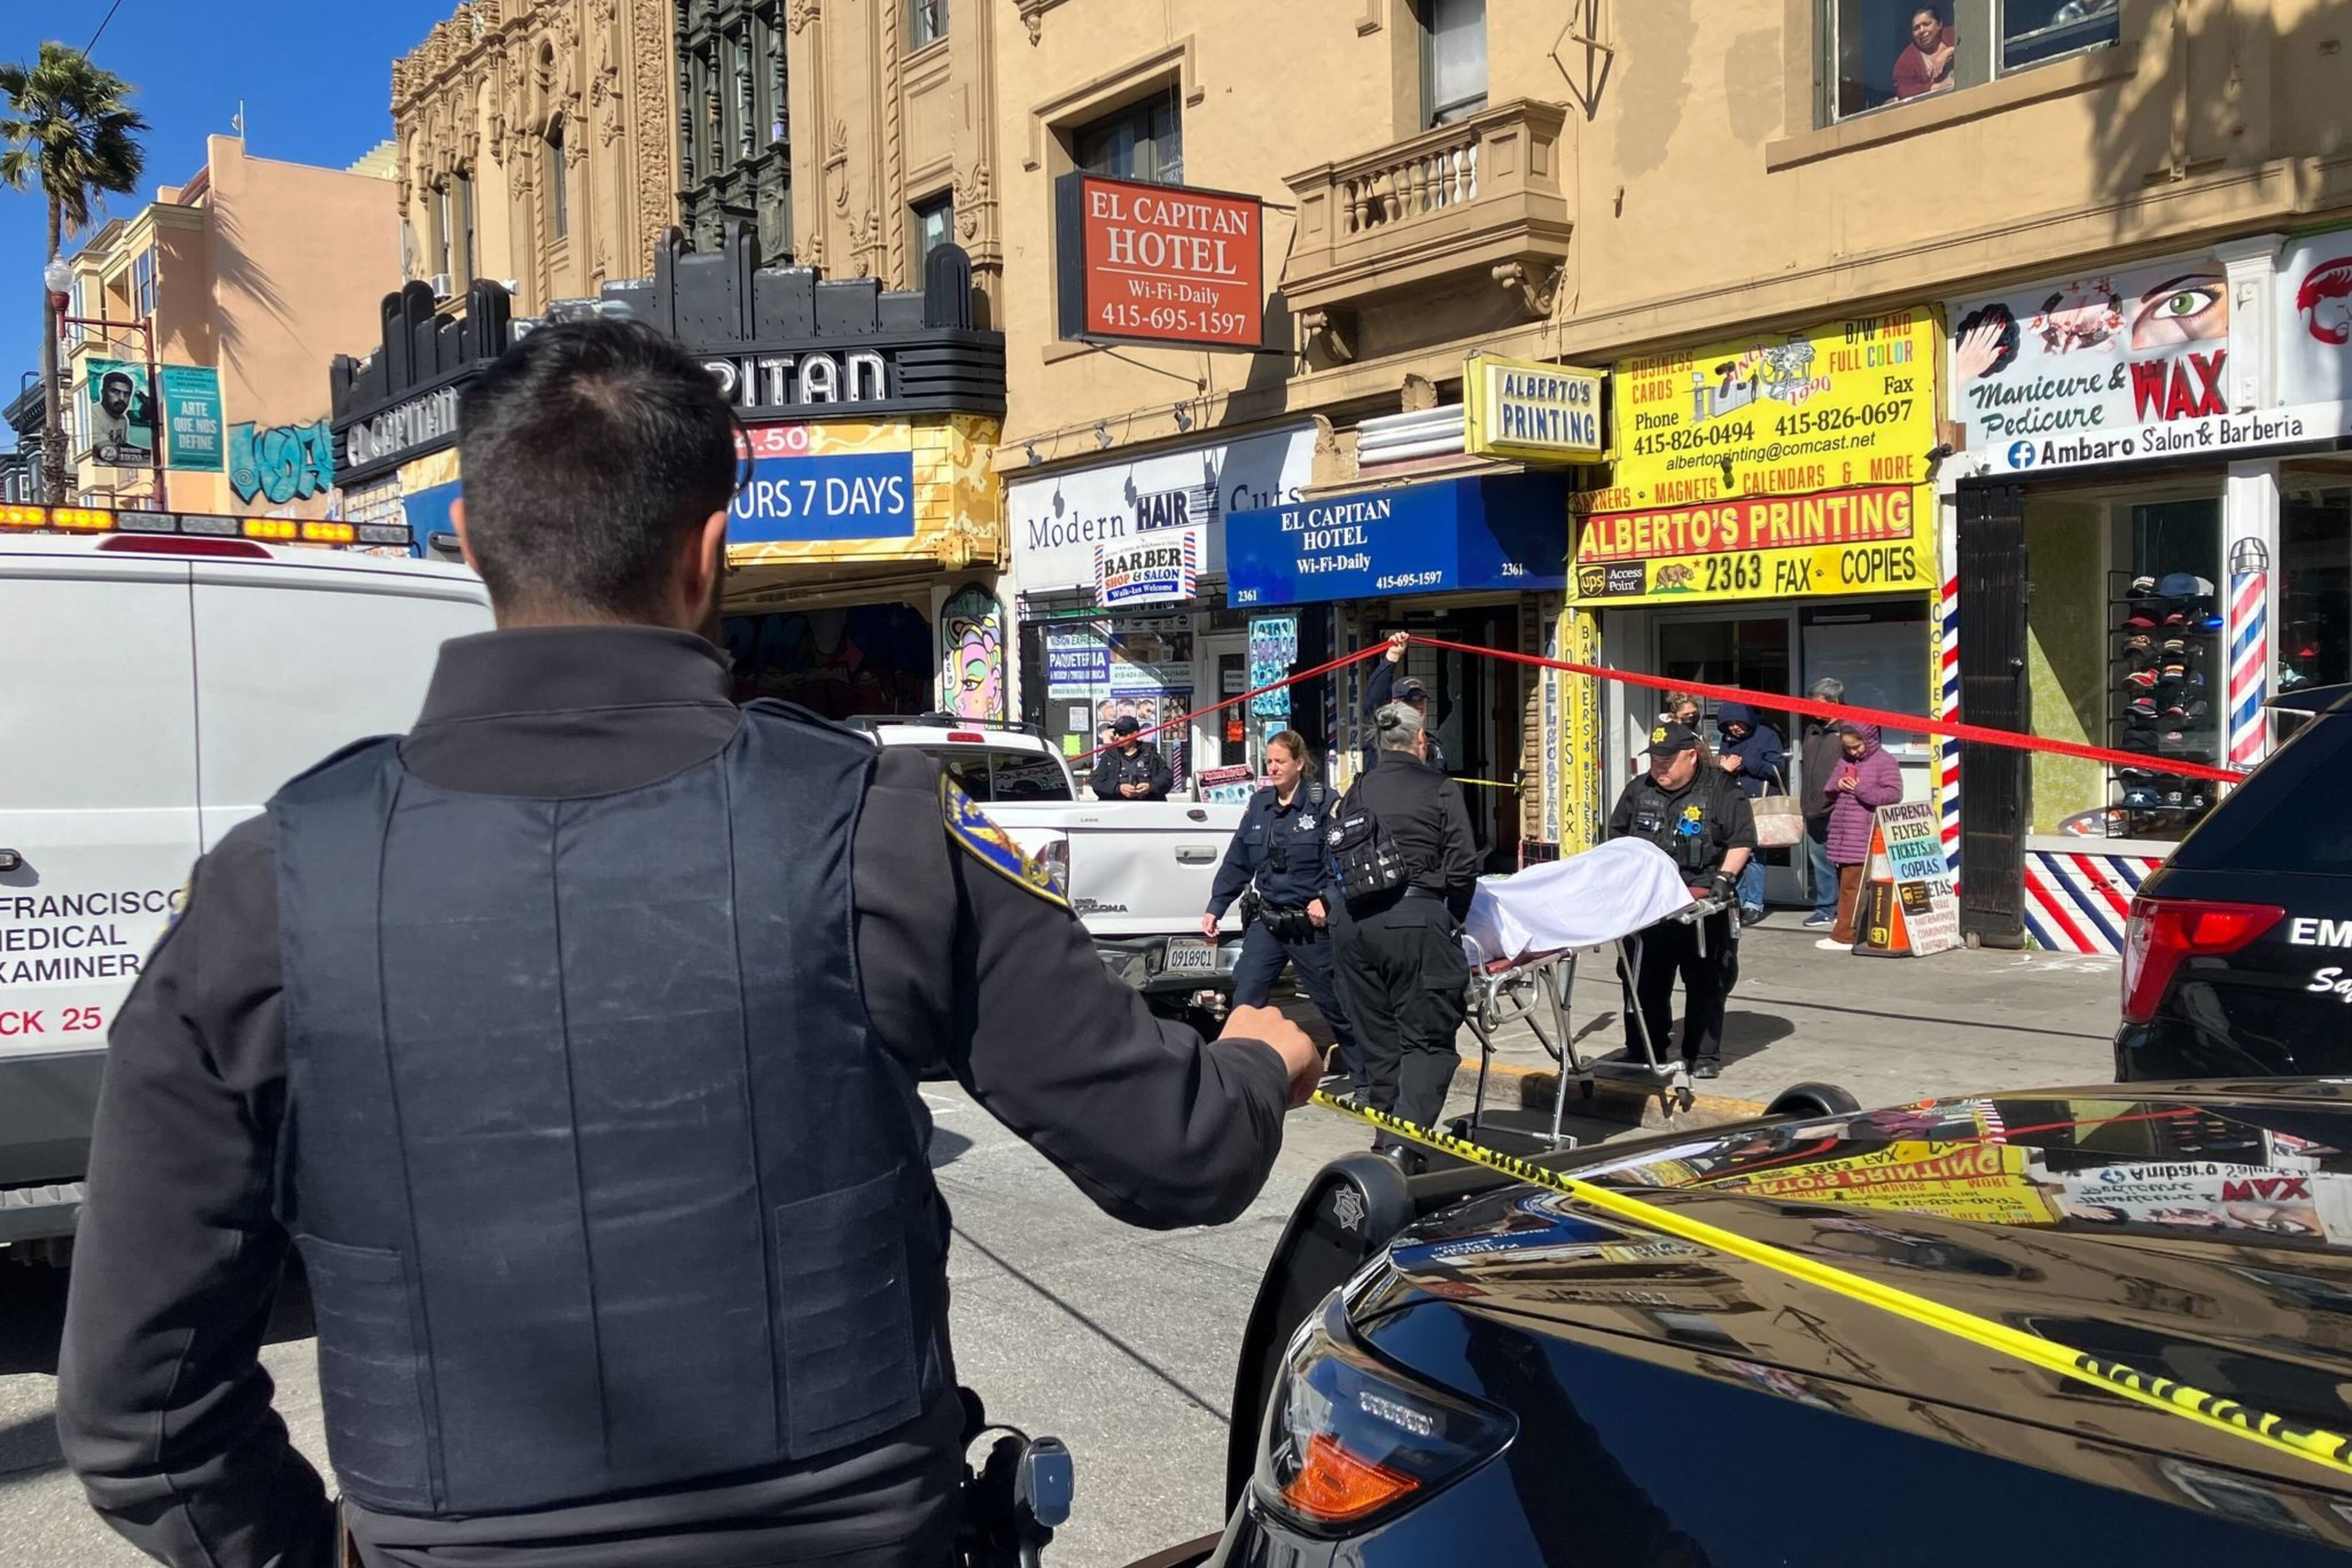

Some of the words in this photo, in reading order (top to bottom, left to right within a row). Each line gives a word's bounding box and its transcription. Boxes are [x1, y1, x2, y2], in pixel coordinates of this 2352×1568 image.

[1091, 191, 1127, 221] EL
[1133, 197, 1249, 236] CAPITAN
[1106, 227, 1236, 275] HOTEL
[1129, 279, 1220, 308] Wi-Fi-Daily
[1102, 303, 1245, 335] 415-695-1597
[1845, 318, 1877, 347] B/W
[1882, 314, 1912, 341] AND
[1632, 351, 1693, 380] BUSINESS
[1726, 343, 1770, 382] SINCE
[1829, 347, 1861, 374] FULL
[1867, 339, 1914, 369] COLOR
[1505, 372, 1591, 405] ALBERTO'S
[1633, 379, 1673, 404] CARDS
[1789, 376, 1831, 406] 1990
[1884, 375, 1913, 396] Fax
[1968, 370, 2104, 410] Manicure
[2108, 362, 2127, 390] &
[2130, 349, 2229, 425] WAX
[181, 401, 208, 417] ARTE
[1635, 412, 1679, 431] Phone
[1980, 404, 2106, 439] Pedicure
[174, 418, 195, 432] QUE
[195, 418, 217, 434] NOS
[1502, 404, 1596, 445] PRINTING
[1634, 420, 1755, 456] 415-826-0494
[1774, 399, 1914, 437] 415-826-0697
[179, 435, 214, 450] DEFINE
[1666, 431, 1876, 472] albertoprinting@comcast.net
[2041, 437, 2135, 465] Ambaro
[2142, 426, 2195, 453] Salon
[2196, 421, 2213, 445] &
[2220, 415, 2304, 445] Barberia
[729, 480, 792, 519] URS
[799, 480, 817, 516] 7
[826, 476, 905, 516] DAYS
[1573, 487, 1630, 512] BANNERS
[1655, 477, 1717, 504] MAGNETS
[1742, 462, 1825, 495] CALENDARS
[1842, 462, 1851, 484] &
[1870, 454, 1914, 480] MORE
[1028, 511, 1125, 551] Modern
[1136, 491, 1190, 529] HAIR
[1281, 512, 1304, 532] EL
[1308, 499, 1391, 529] CAPITAN
[1578, 506, 1739, 557] ALBERTO'S
[1749, 489, 1910, 547] PRINTING
[1303, 526, 1368, 551] HOTEL
[1104, 548, 1182, 578] BARBER
[1296, 554, 1371, 575] Wi-Fi-Daily
[1502, 562, 1524, 576] 2361
[1705, 552, 1763, 590] 2363
[1775, 557, 1812, 593] FAX
[1840, 546, 1916, 584] COPIES
[1105, 573, 1131, 590] SHOP
[1133, 571, 1141, 582] &
[1144, 568, 1181, 581] SALON
[1111, 586, 1141, 598] Walk-Ins
[1144, 584, 1173, 594] Welcome
[1376, 571, 1442, 590] 415-695-1597
[1582, 575, 1603, 592] ups
[1609, 569, 1643, 579] Access
[1609, 581, 1635, 591] Point
[1238, 590, 1257, 603] 2361
[1565, 784, 1574, 834] FAX
[1881, 804, 1934, 823] IMPRENTA
[1892, 821, 1930, 842] FLYERS
[1888, 840, 1927, 861] TICKETS
[1900, 858, 1940, 878] COPIAS
[0, 924, 127, 952] EDICAL
[1171, 950, 1212, 967] 09189C1
[62, 1006, 102, 1031] 25
